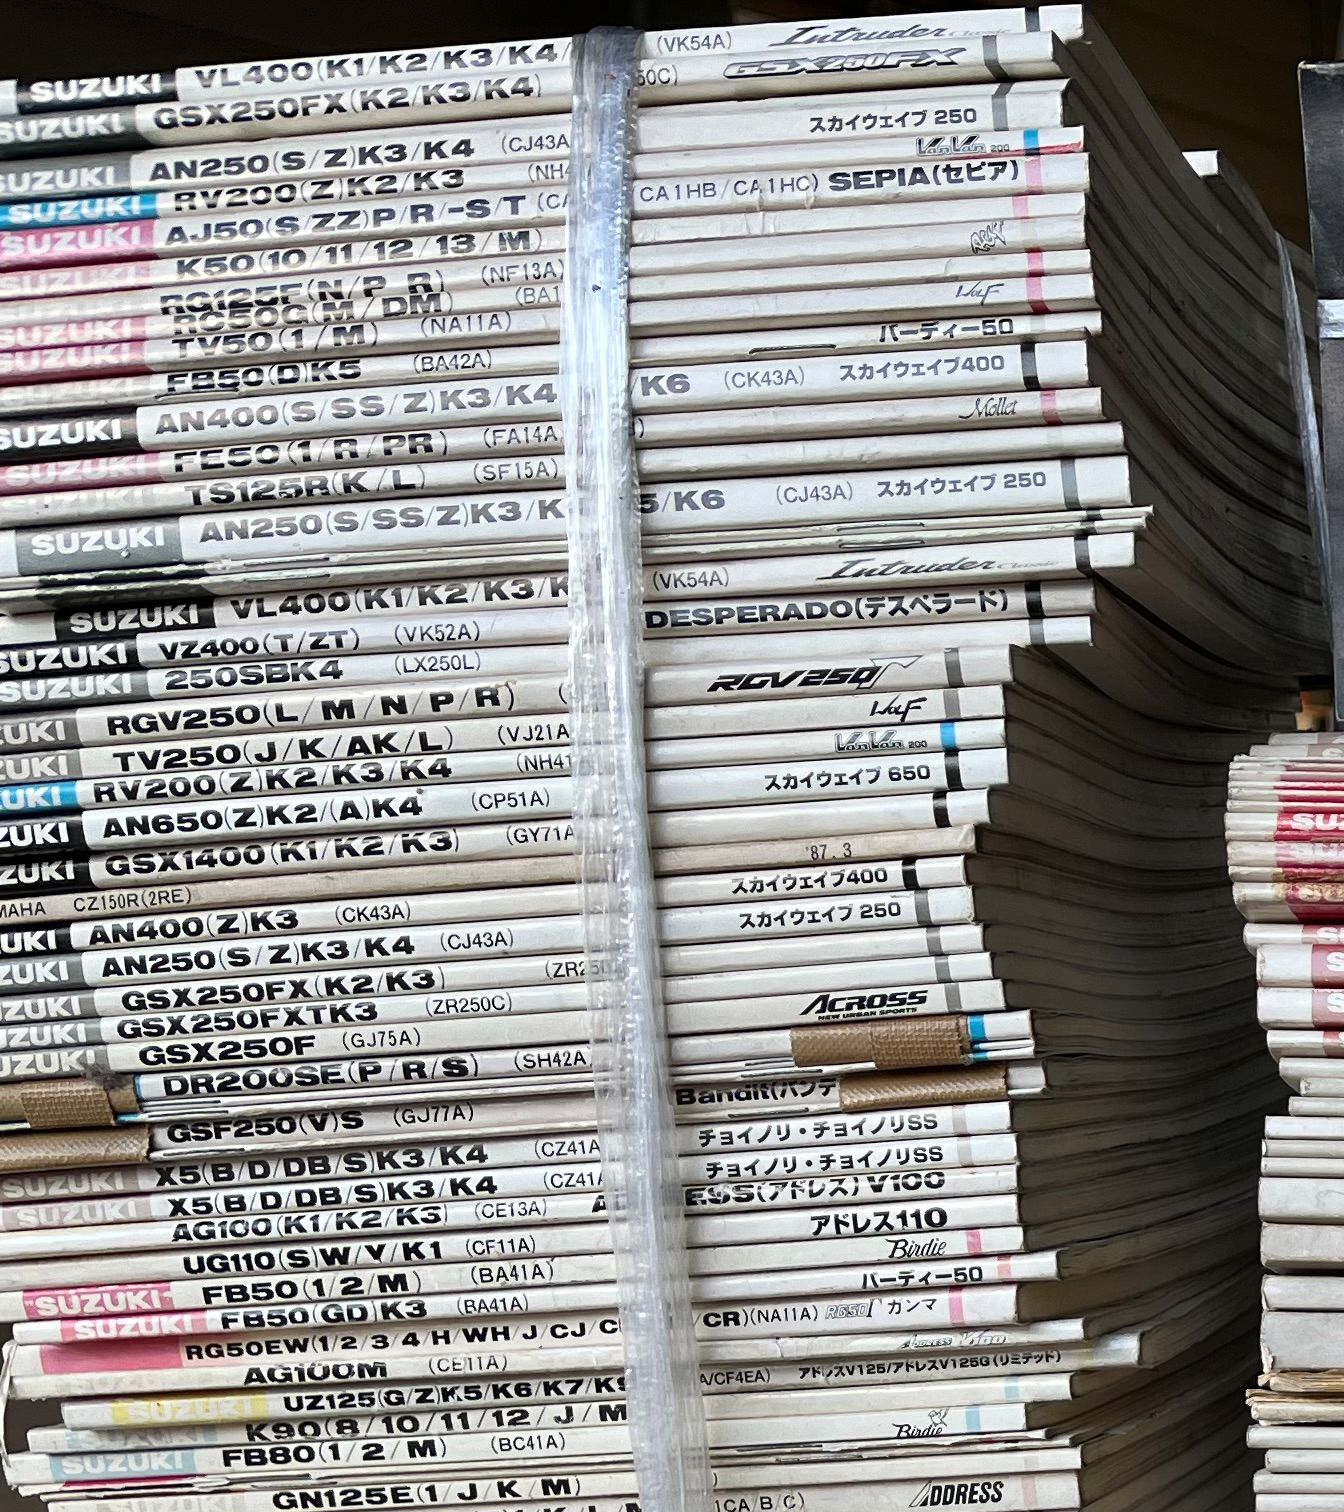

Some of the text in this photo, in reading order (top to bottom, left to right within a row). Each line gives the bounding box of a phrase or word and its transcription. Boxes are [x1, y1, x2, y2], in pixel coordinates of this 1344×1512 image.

[30, 73, 161, 102] SUZUKI
[935, 108, 977, 127] 250
[9, 196, 140, 224] SUZUKI
[724, 366, 805, 388] (CK43A)
[1003, 470, 1046, 489] 250
[31, 528, 166, 556] SUZUKI
[70, 604, 199, 633] SUZUKI
[394, 622, 481, 645] (VK52A)
[888, 765, 930, 782] 650
[471, 787, 551, 811] (CP51A)
[860, 901, 901, 920] 250
[800, 990, 929, 1015] ACROSS
[139, 1036, 316, 1066] GSX250F
